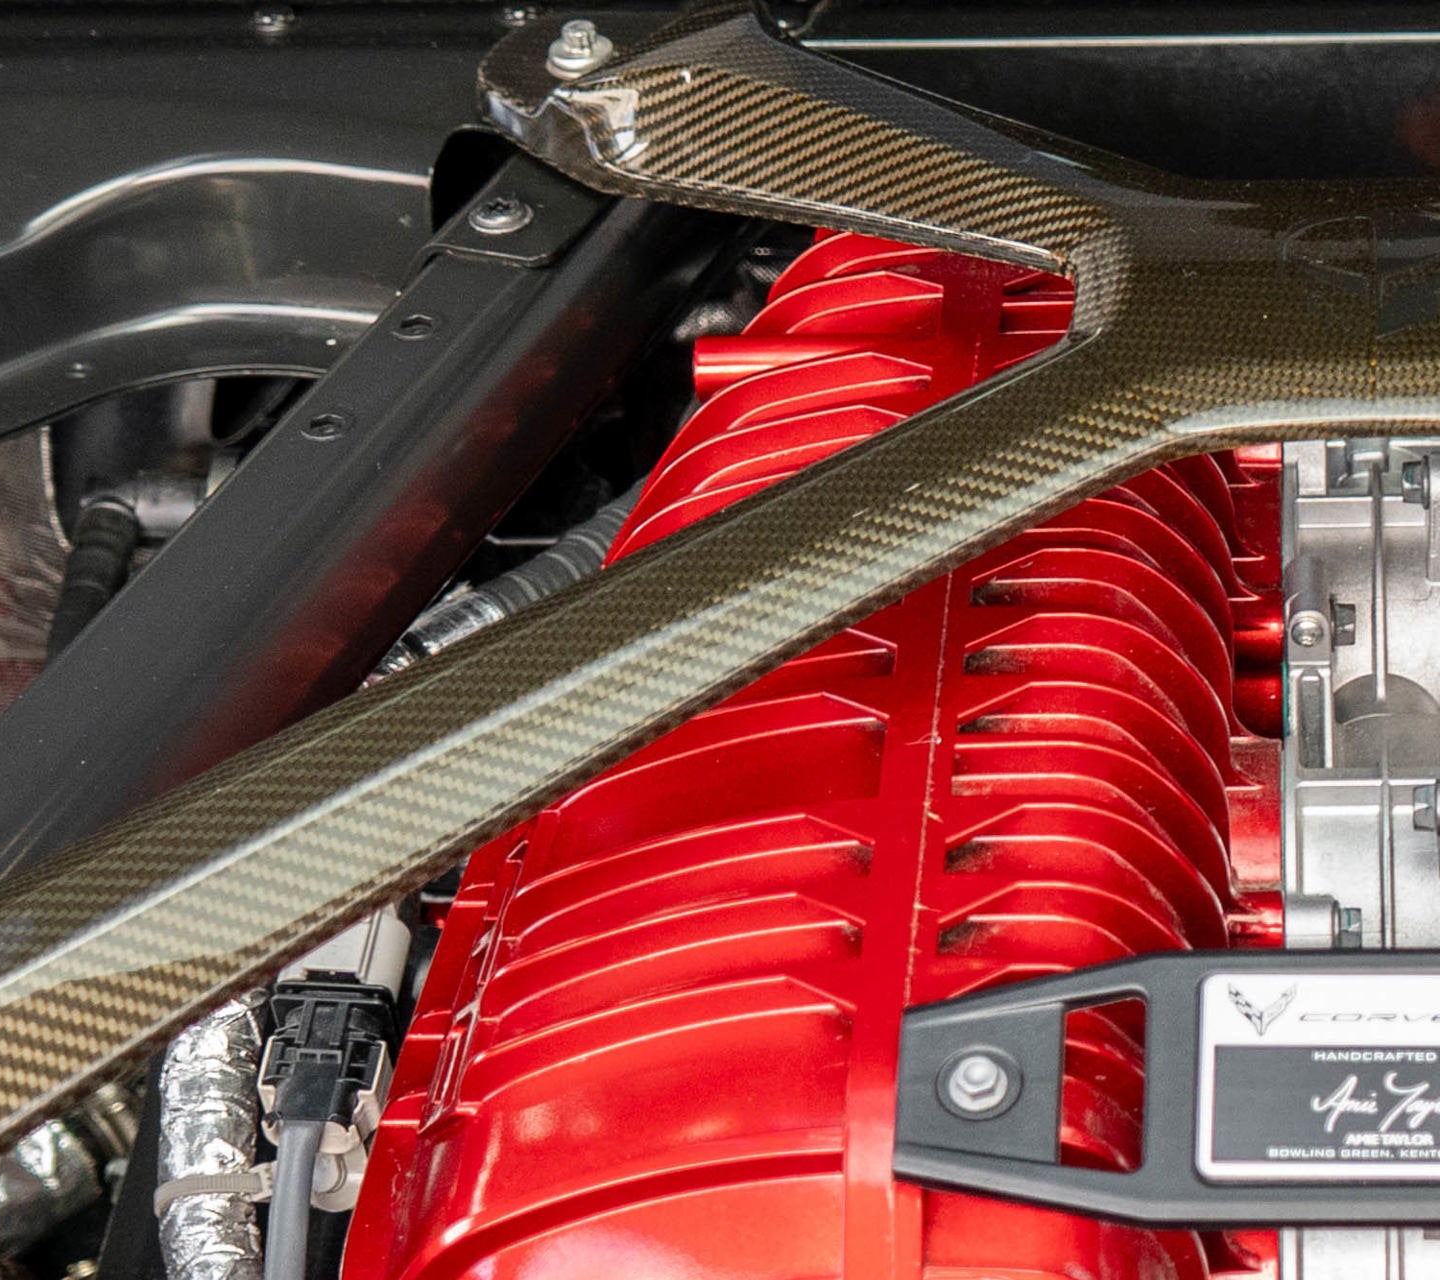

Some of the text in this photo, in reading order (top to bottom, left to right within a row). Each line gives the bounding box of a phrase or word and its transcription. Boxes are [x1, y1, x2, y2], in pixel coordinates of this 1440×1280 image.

[1312, 1050, 1438, 1063] HANDCRAFTED
[1380, 1133, 1435, 1146] TAYLOR
[1267, 1148, 1336, 1160] BOWLING
